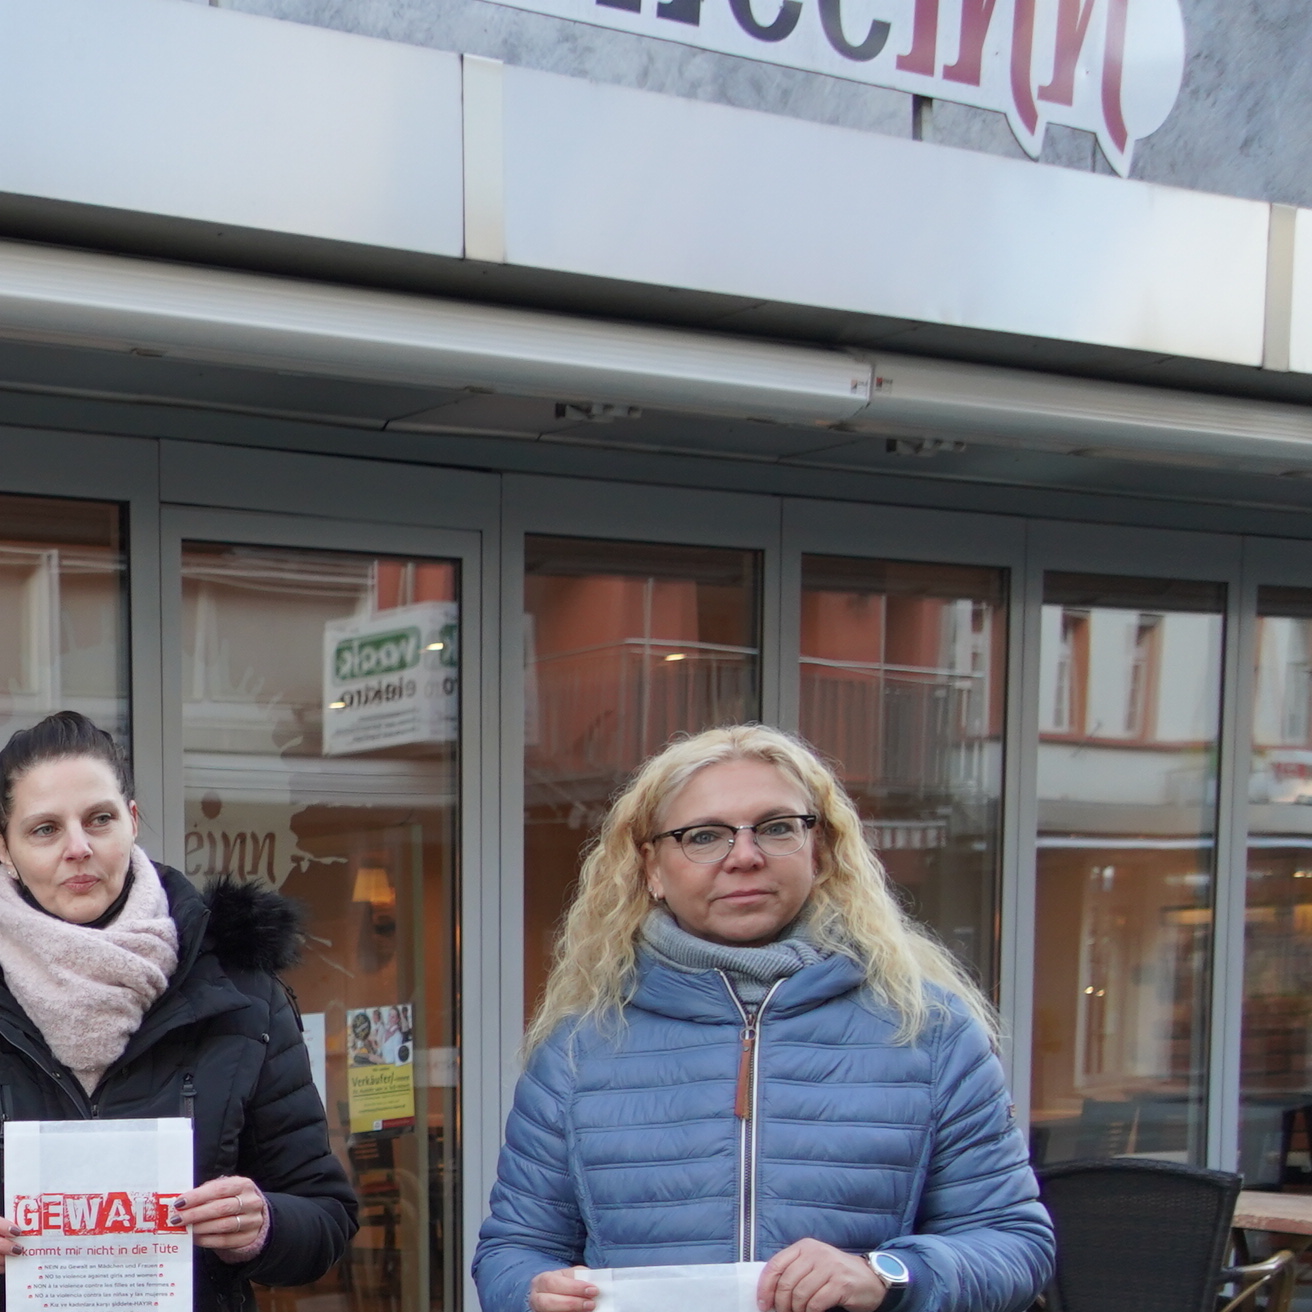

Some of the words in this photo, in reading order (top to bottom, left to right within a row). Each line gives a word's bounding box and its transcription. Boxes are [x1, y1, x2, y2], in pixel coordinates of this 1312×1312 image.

[13, 1191, 189, 1236] GEWALT
[21, 1245, 62, 1257] kommt
[64, 1245, 83, 1256] mir
[87, 1244, 115, 1256] nicht
[118, 1244, 130, 1256] in
[131, 1243, 148, 1255] die
[151, 1243, 179, 1255] Tüte
